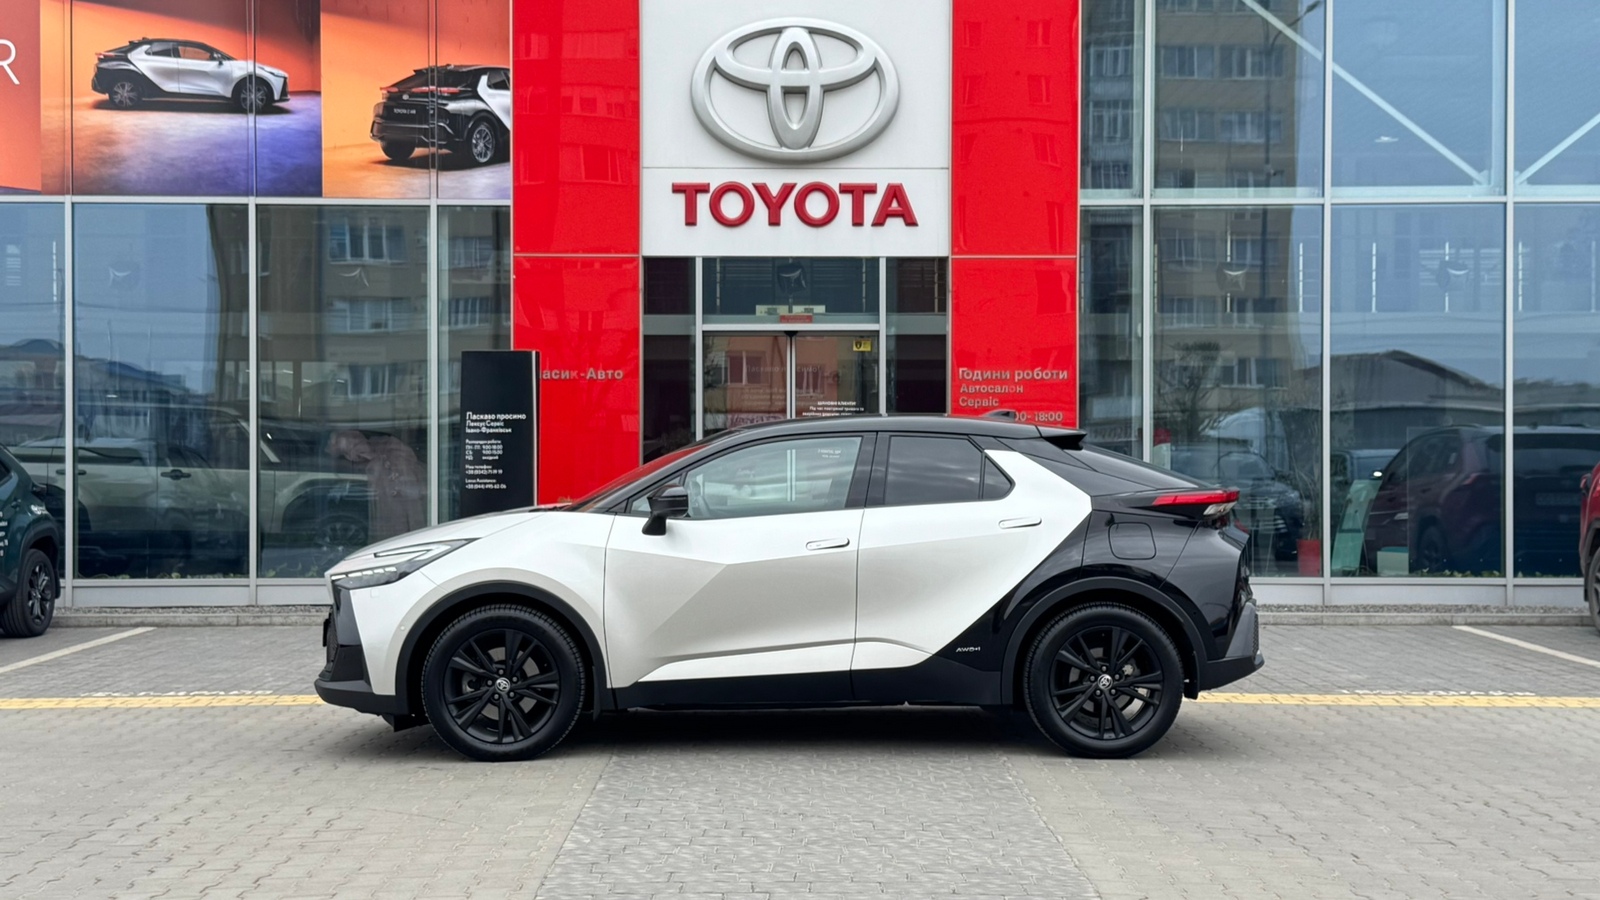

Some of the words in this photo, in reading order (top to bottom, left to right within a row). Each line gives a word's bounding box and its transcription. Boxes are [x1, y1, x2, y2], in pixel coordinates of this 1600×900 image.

[672, 181, 918, 227] TOYOTA
[958, 367, 1010, 381] Години
[1014, 367, 1068, 382] роботи
[960, 384, 1024, 394] Автосалон
[958, 396, 999, 408] Сервіс
[466, 412, 496, 420] Ласкаво
